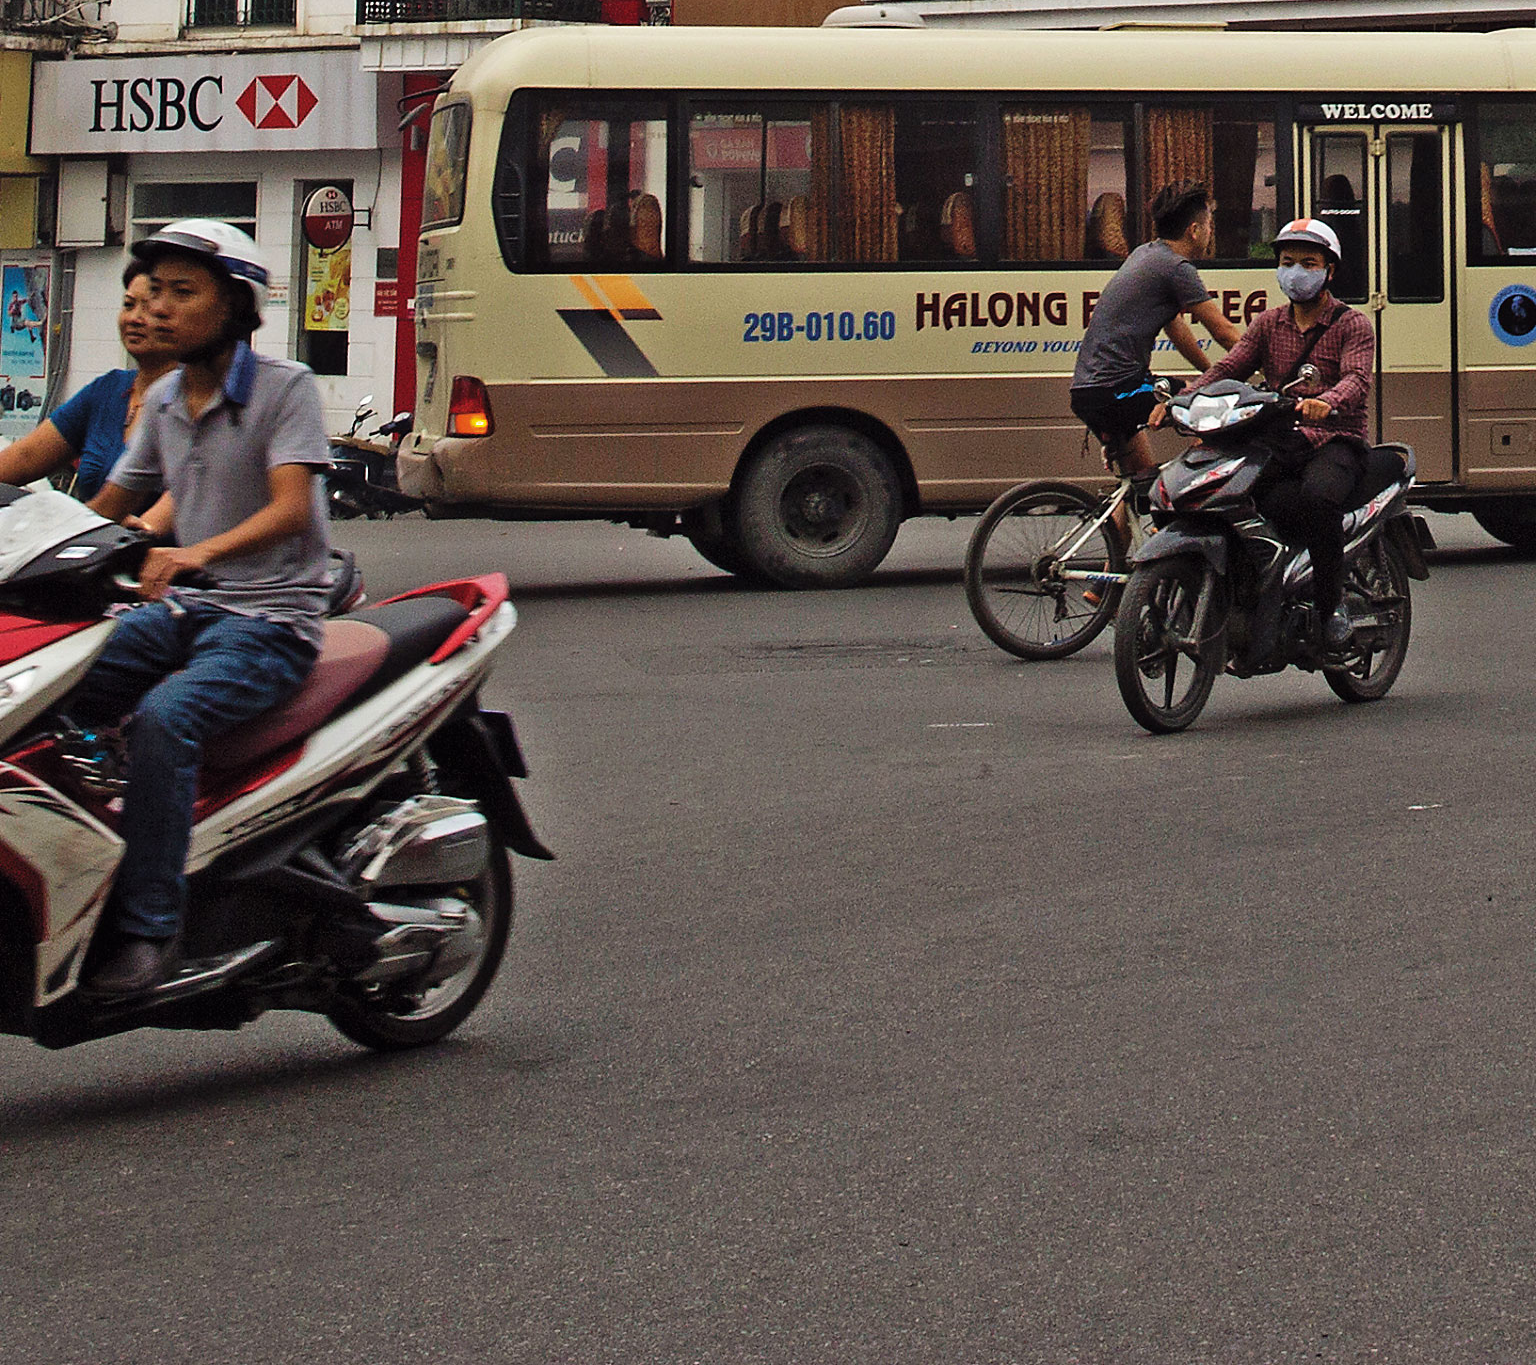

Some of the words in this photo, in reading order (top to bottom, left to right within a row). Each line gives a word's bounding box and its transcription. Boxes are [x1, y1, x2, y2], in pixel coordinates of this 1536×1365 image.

[88, 75, 224, 133] HSBC
[1320, 103, 1434, 120] WELCOME
[319, 200, 347, 213] HSBC
[324, 219, 343, 230] ATM
[915, 290, 1068, 332] HALONG
[742, 310, 896, 343] 29B-010.60
[970, 340, 1039, 355] BEYOND
